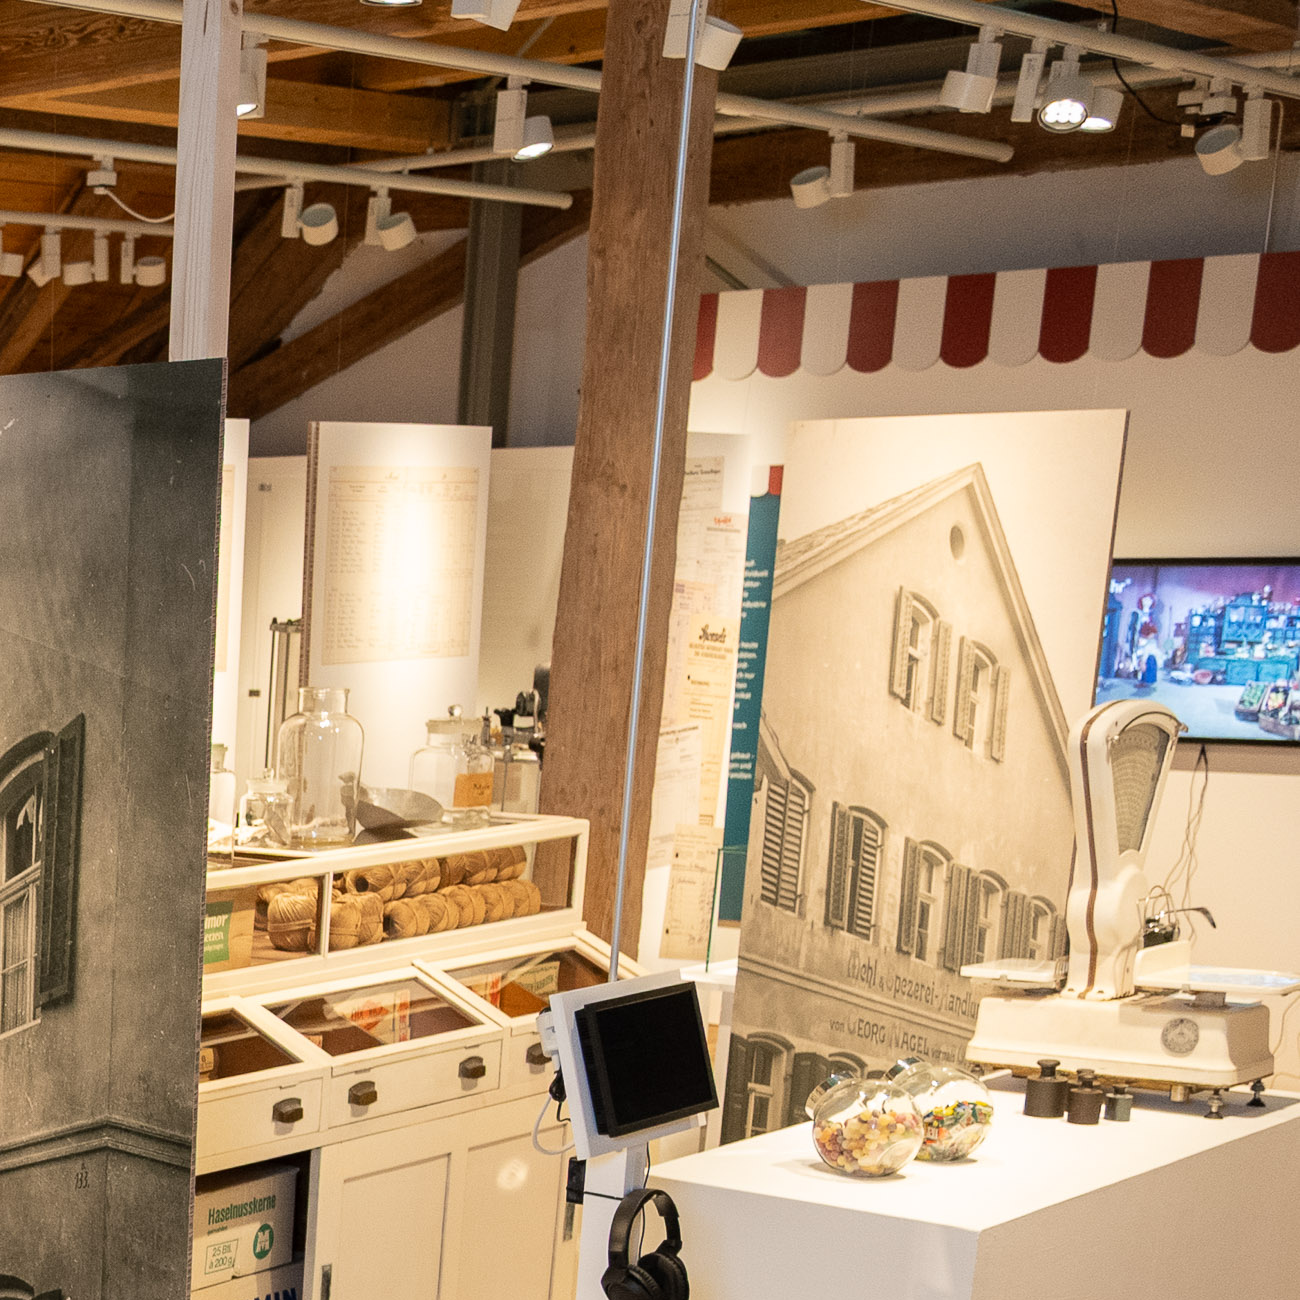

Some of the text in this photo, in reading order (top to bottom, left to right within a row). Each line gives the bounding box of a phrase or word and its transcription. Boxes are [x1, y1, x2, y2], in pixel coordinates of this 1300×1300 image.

[847, 951, 877, 986] Mehl
[829, 1018, 845, 1032] von
[208, 1194, 276, 1225] Haselnusskerne
[212, 1246, 221, 1257] 25
[214, 1256, 228, 1267] 200
